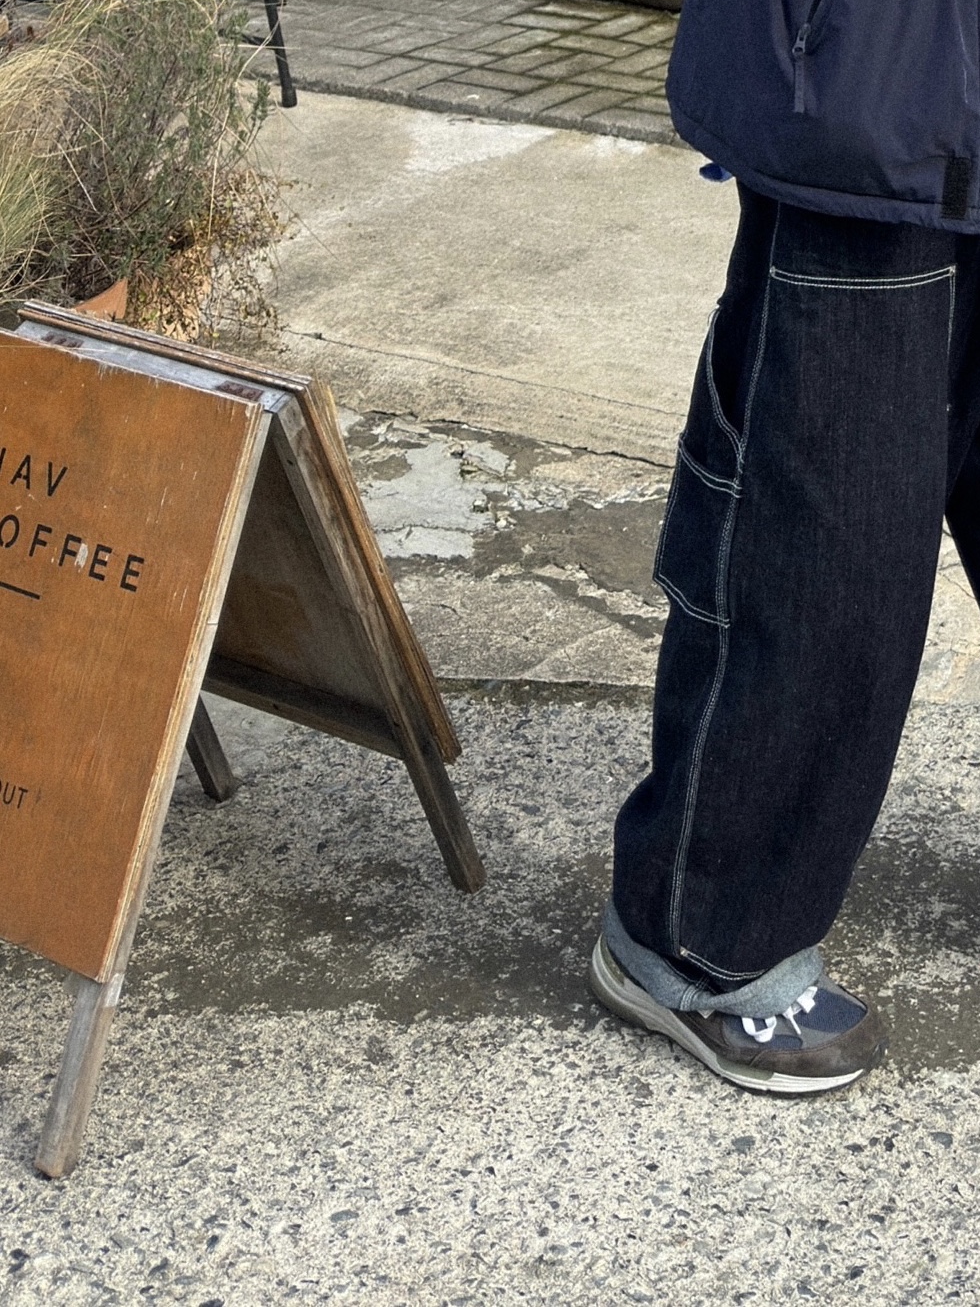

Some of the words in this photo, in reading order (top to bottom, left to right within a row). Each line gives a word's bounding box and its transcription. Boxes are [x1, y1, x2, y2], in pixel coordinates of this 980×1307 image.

[0, 447, 68, 497] AV
[0, 514, 145, 592] OFFEE
[0, 779, 29, 809] UT
